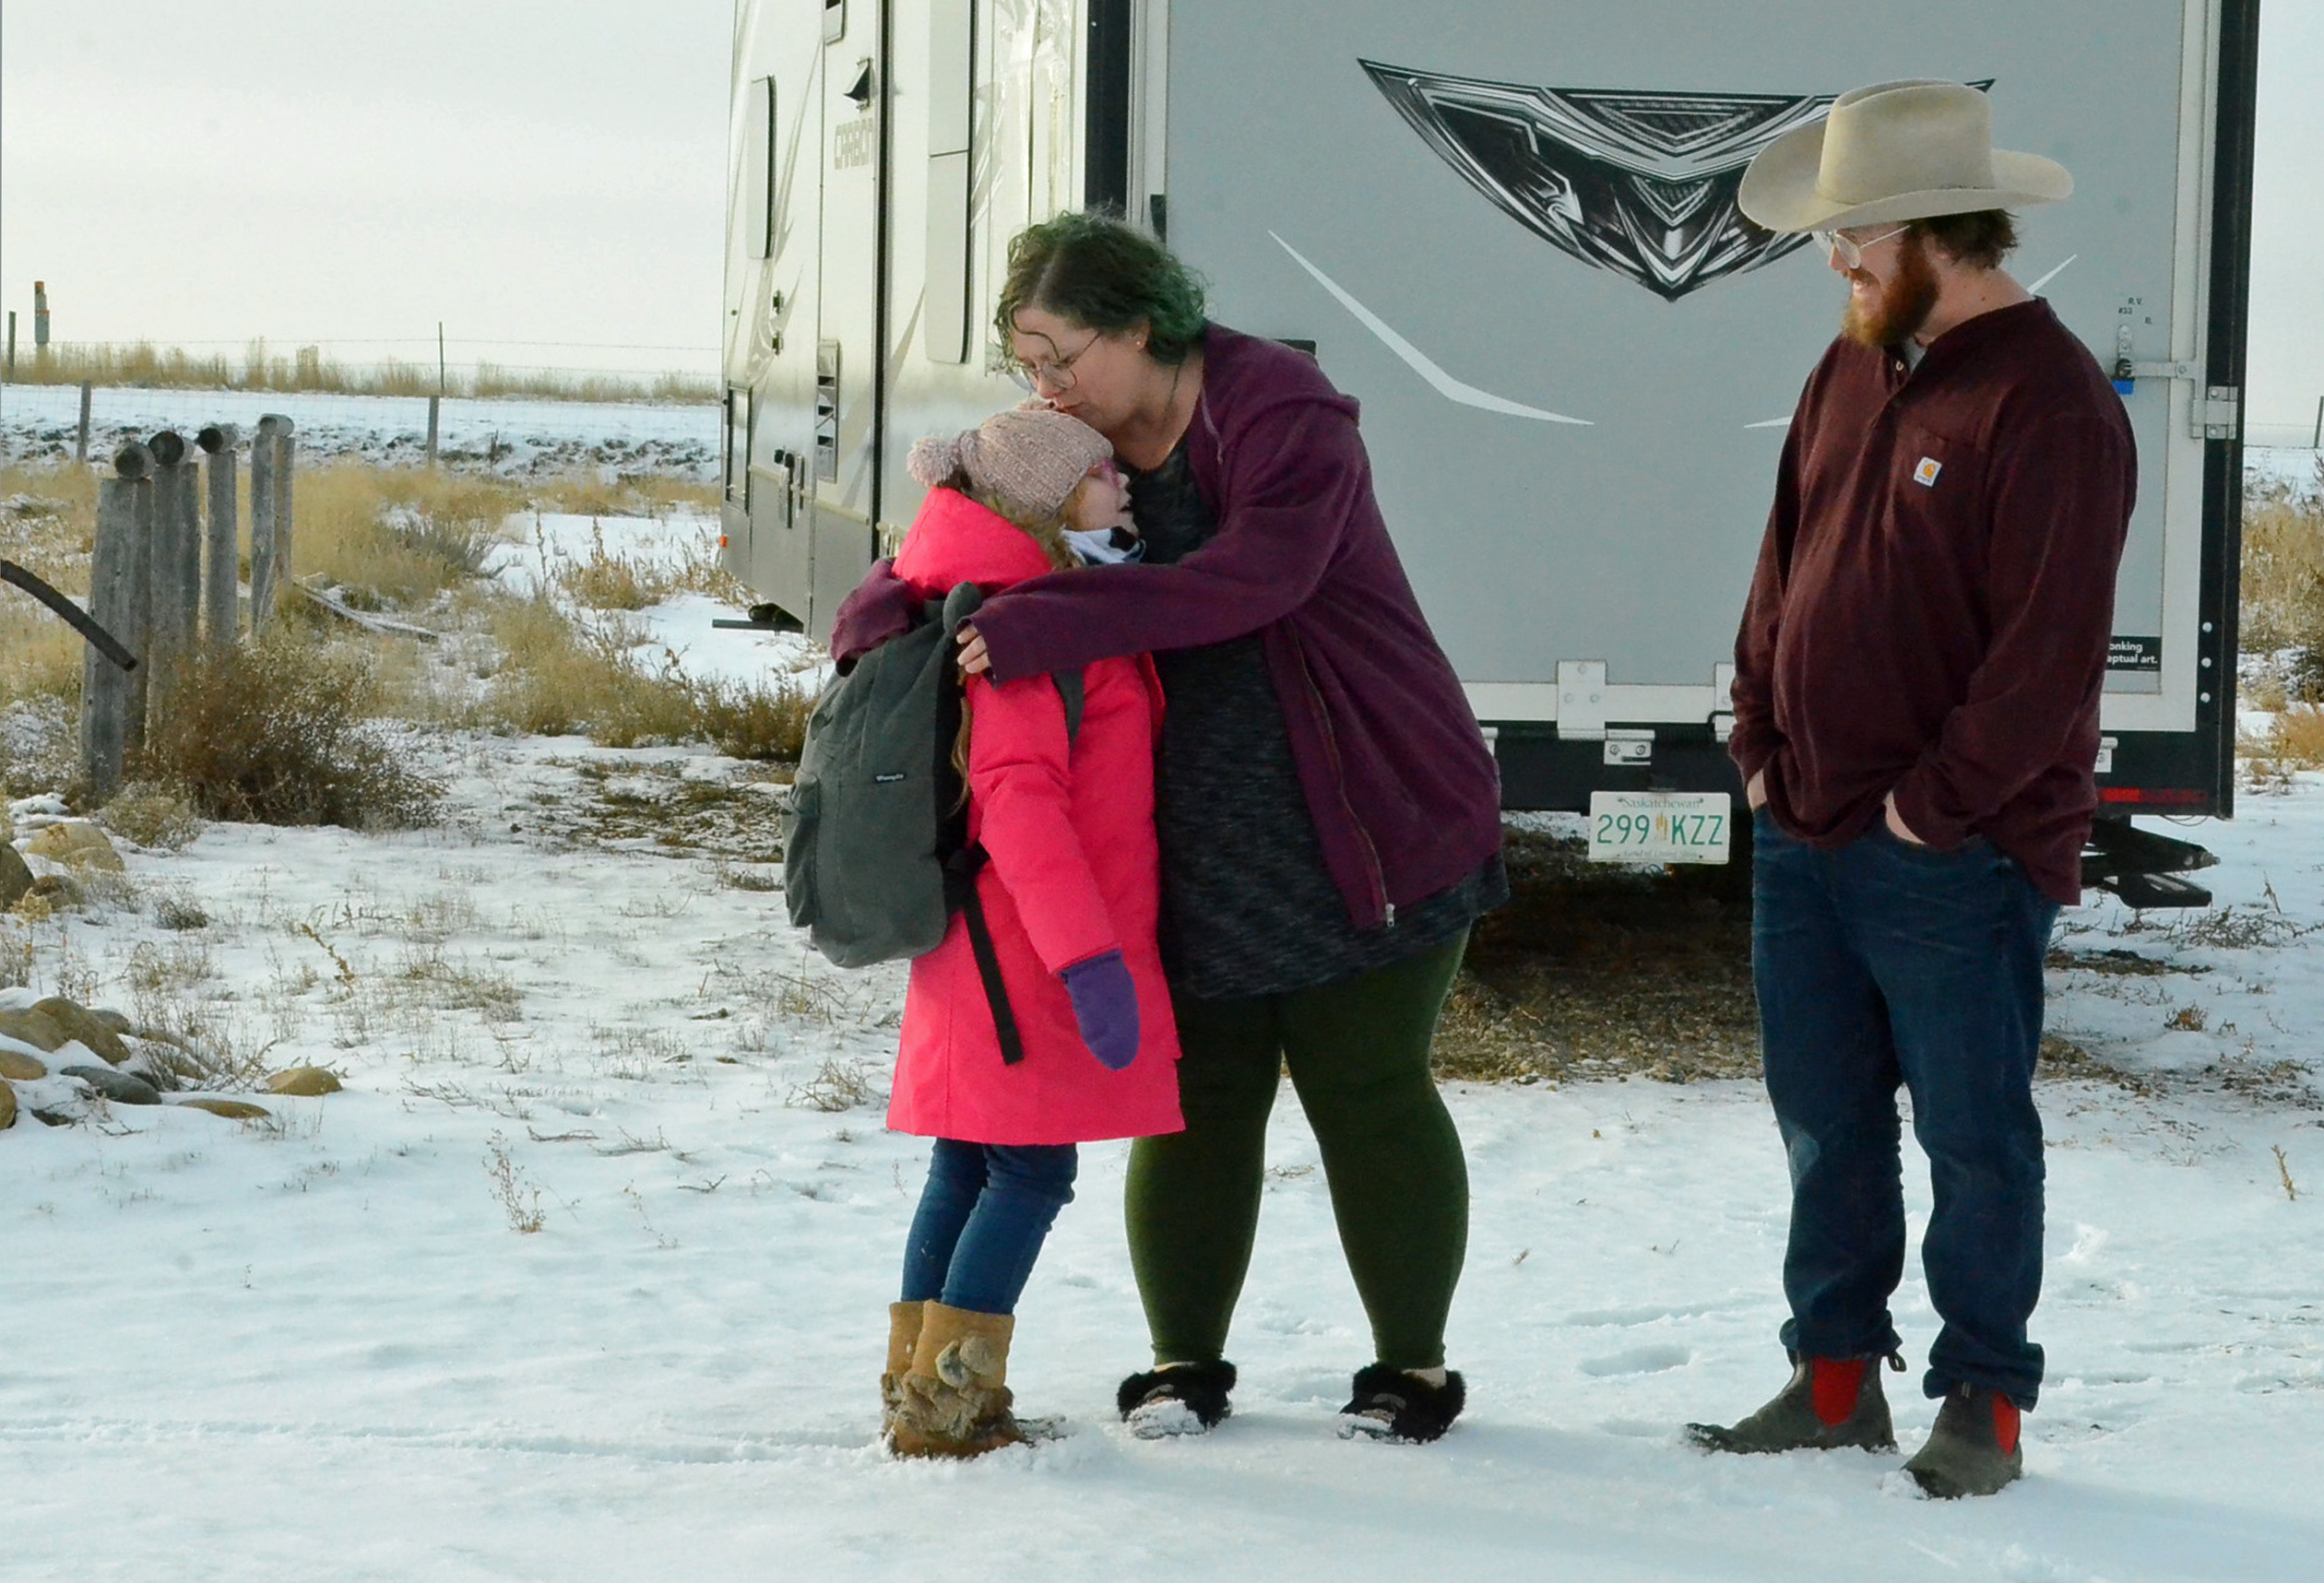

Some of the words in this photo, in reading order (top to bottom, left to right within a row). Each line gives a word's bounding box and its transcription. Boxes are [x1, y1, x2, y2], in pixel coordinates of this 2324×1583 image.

[2140, 655, 2158, 664] art.
[1620, 796, 1702, 809] Saskatchewan
[1596, 814, 1651, 845] 299
[1671, 815, 1724, 845] KZZ
